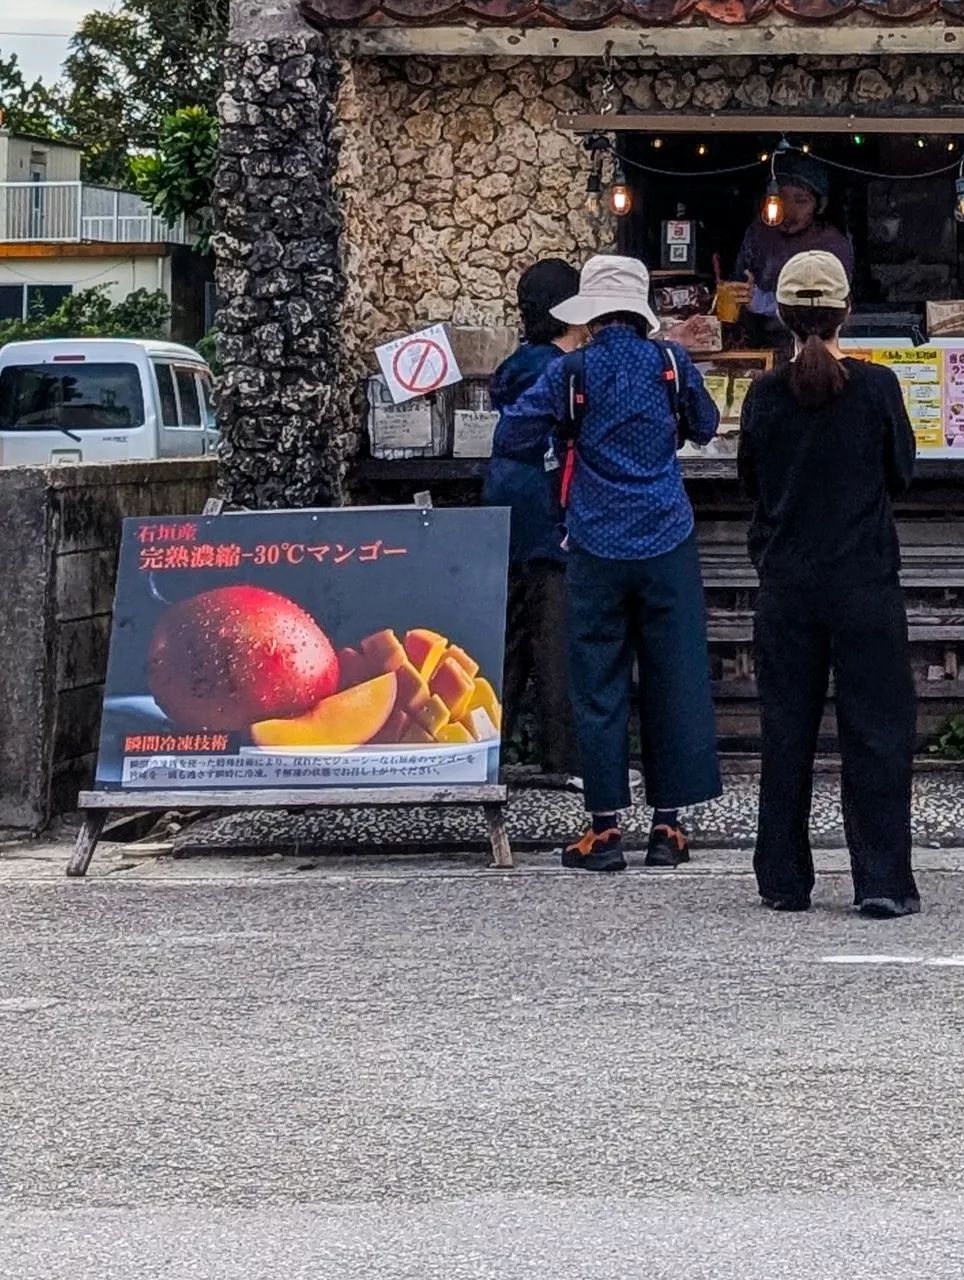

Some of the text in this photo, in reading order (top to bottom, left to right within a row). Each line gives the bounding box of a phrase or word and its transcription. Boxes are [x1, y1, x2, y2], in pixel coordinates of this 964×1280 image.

[138, 523, 198, 544] 石垣産
[124, 734, 228, 753] 瞬間冷凍技術
